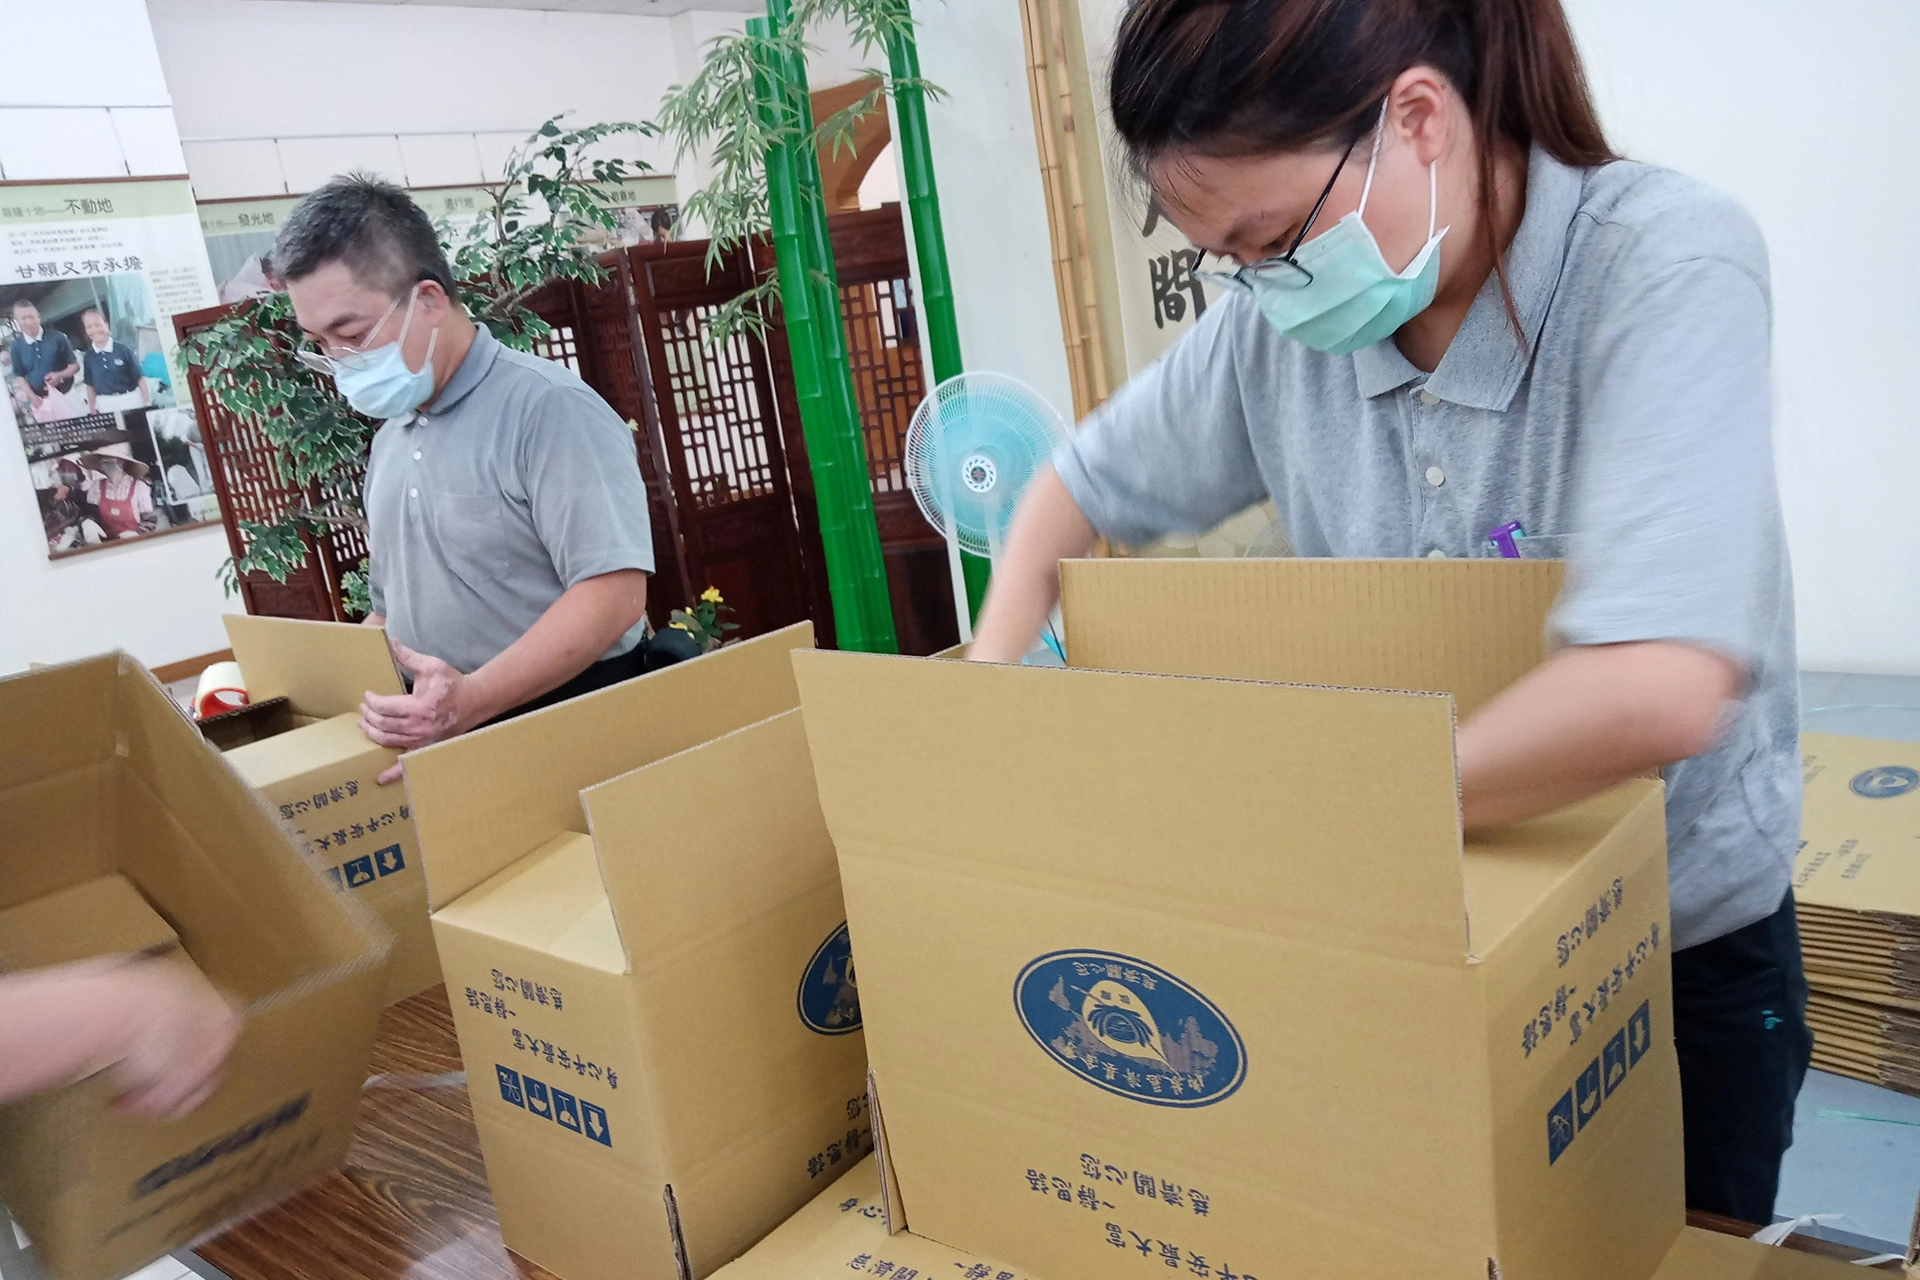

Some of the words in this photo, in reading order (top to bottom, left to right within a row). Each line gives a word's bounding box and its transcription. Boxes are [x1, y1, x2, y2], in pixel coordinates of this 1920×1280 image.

[63, 198, 114, 215] 不動地
[511, 1028, 618, 1090] 身心平安最大富
[1080, 1153, 1210, 1217] 慈濟關心您
